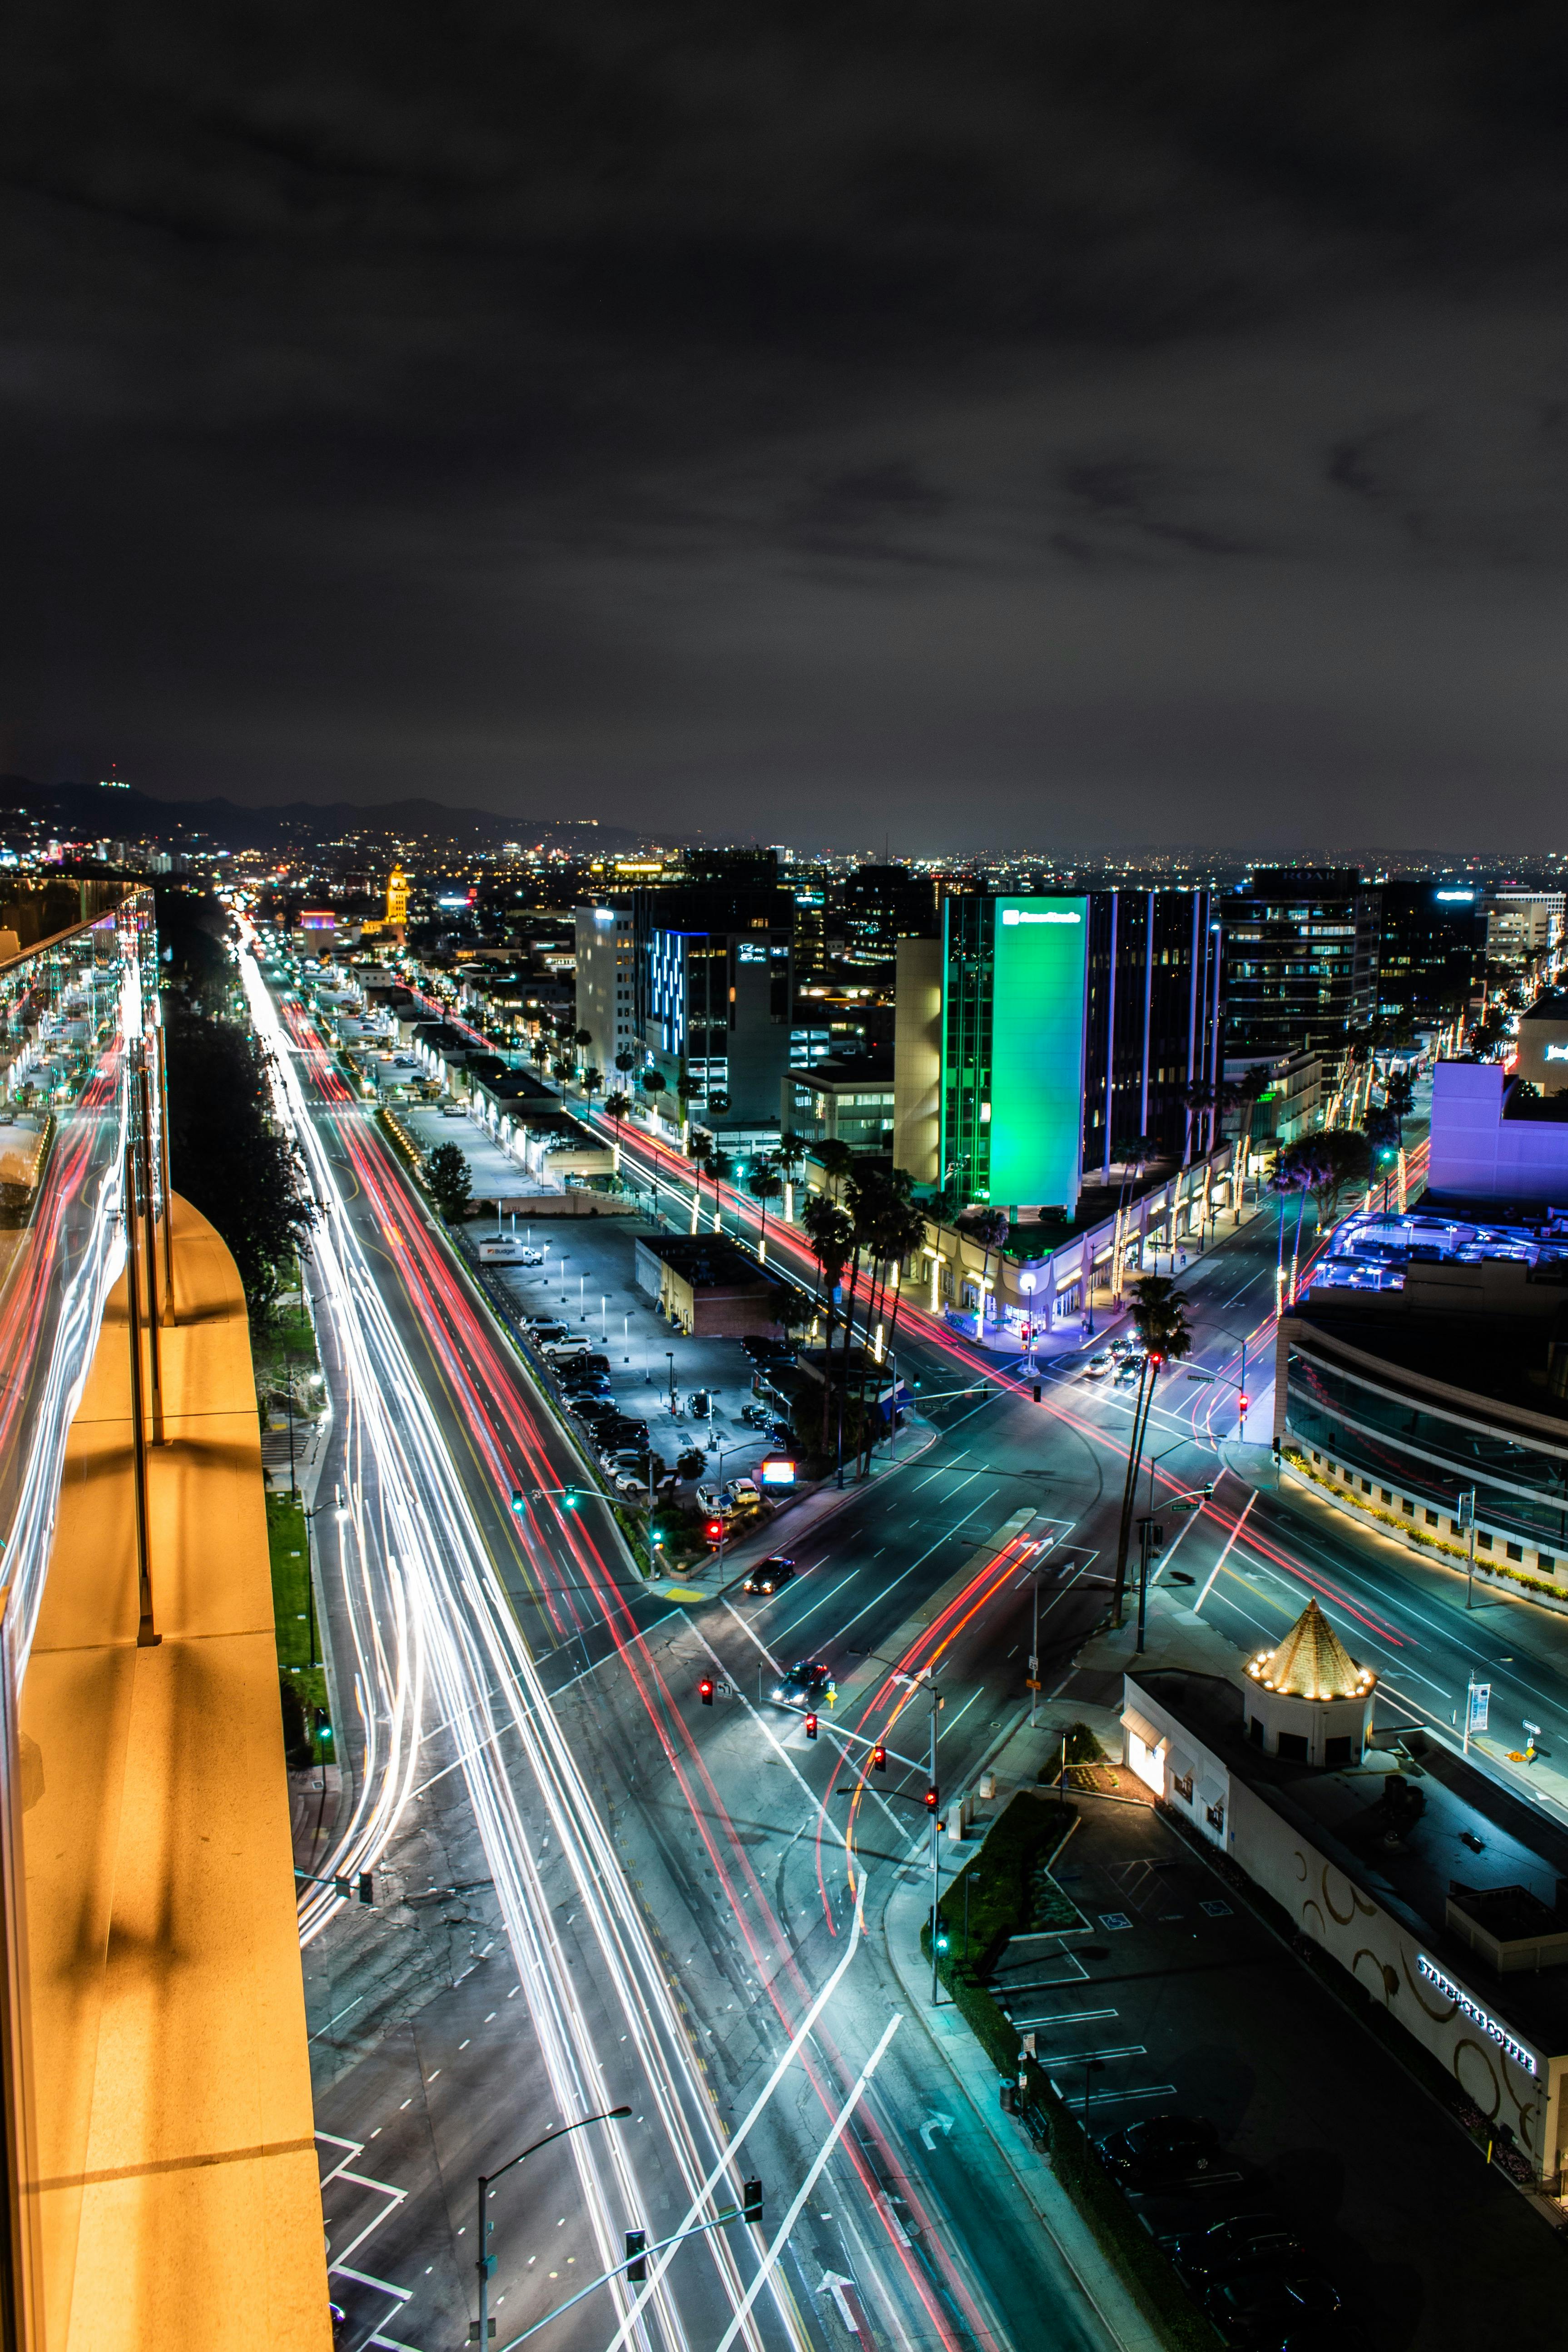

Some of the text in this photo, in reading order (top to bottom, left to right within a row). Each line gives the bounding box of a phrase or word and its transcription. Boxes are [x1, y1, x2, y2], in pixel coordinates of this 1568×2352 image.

[1282, 872, 1335, 880] ROAR
[1418, 1957, 1534, 2073] STARBUCKS COFFEE
